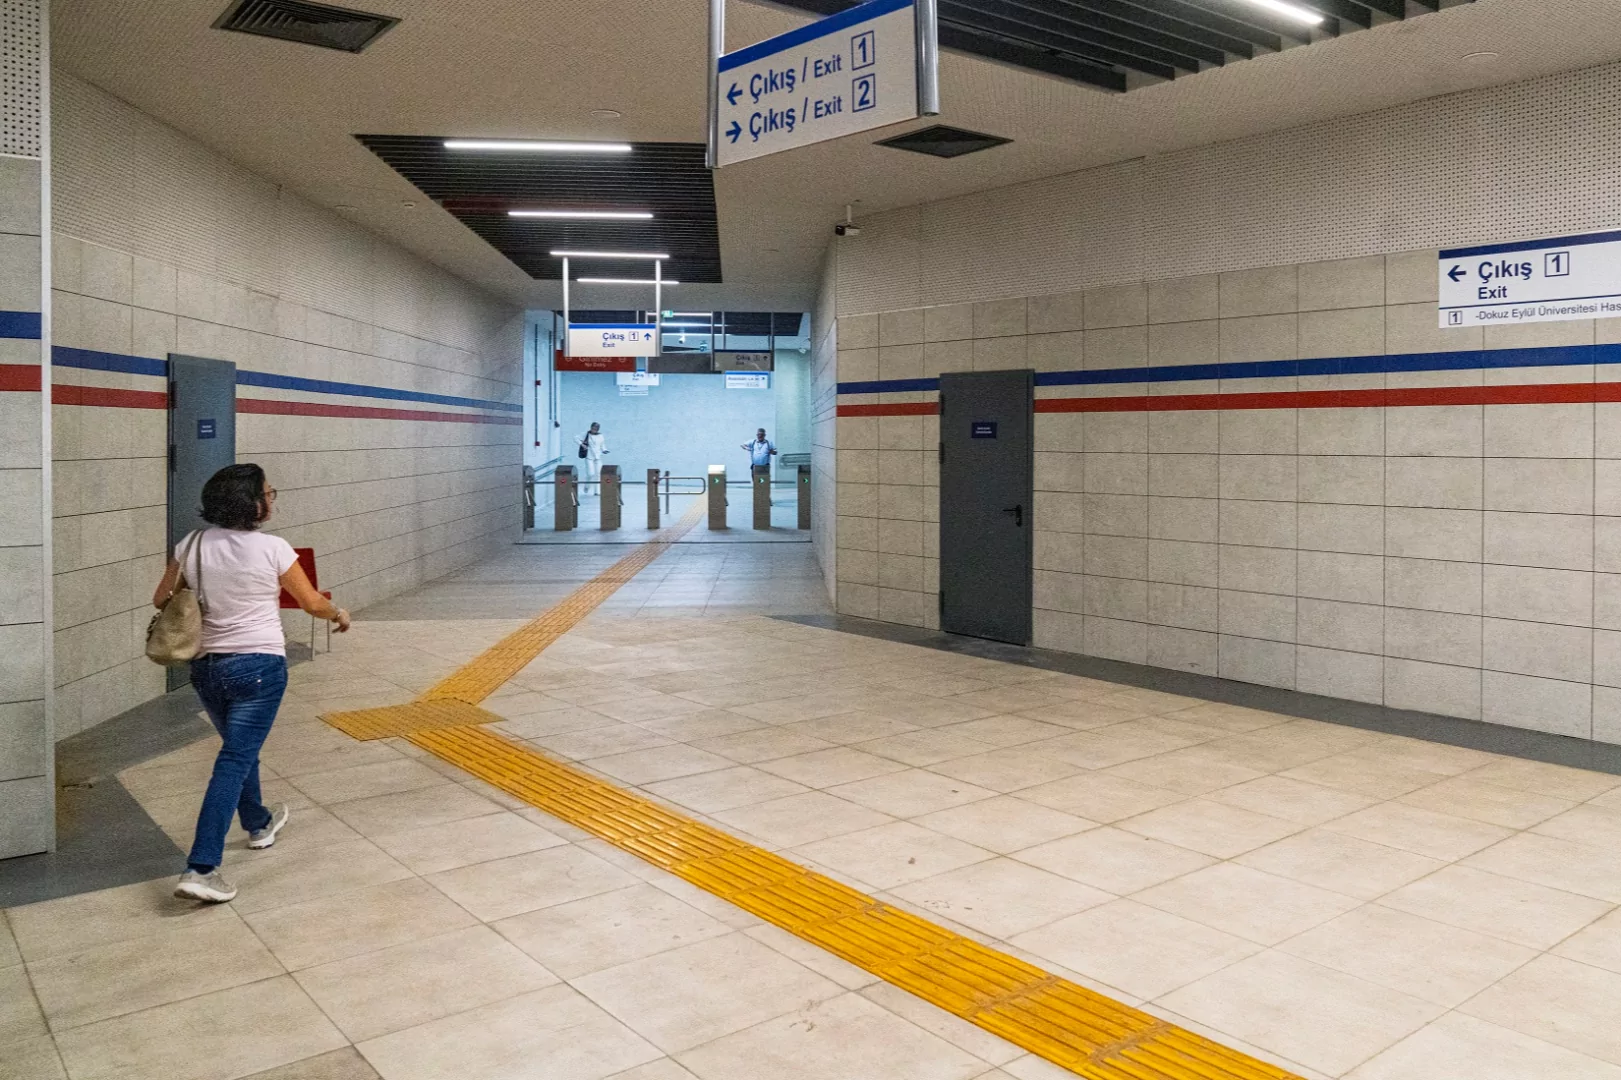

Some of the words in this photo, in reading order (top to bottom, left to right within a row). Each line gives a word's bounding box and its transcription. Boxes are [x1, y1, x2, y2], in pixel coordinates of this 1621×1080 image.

[750, 69, 796, 103] Çıkış
[814, 54, 842, 79] Exit
[858, 37, 867, 63] 1
[750, 108, 796, 142] Çıkış
[814, 96, 842, 119] Exit
[858, 79, 870, 107] 2
[1478, 260, 1533, 284] Çıkış
[1551, 255, 1561, 273] 1
[1478, 286, 1508, 300] Exit
[1512, 307, 1536, 320] Eylül
[1538, 303, 1598, 316] Üniversitesi
[602, 332, 625, 341] Çıkış
